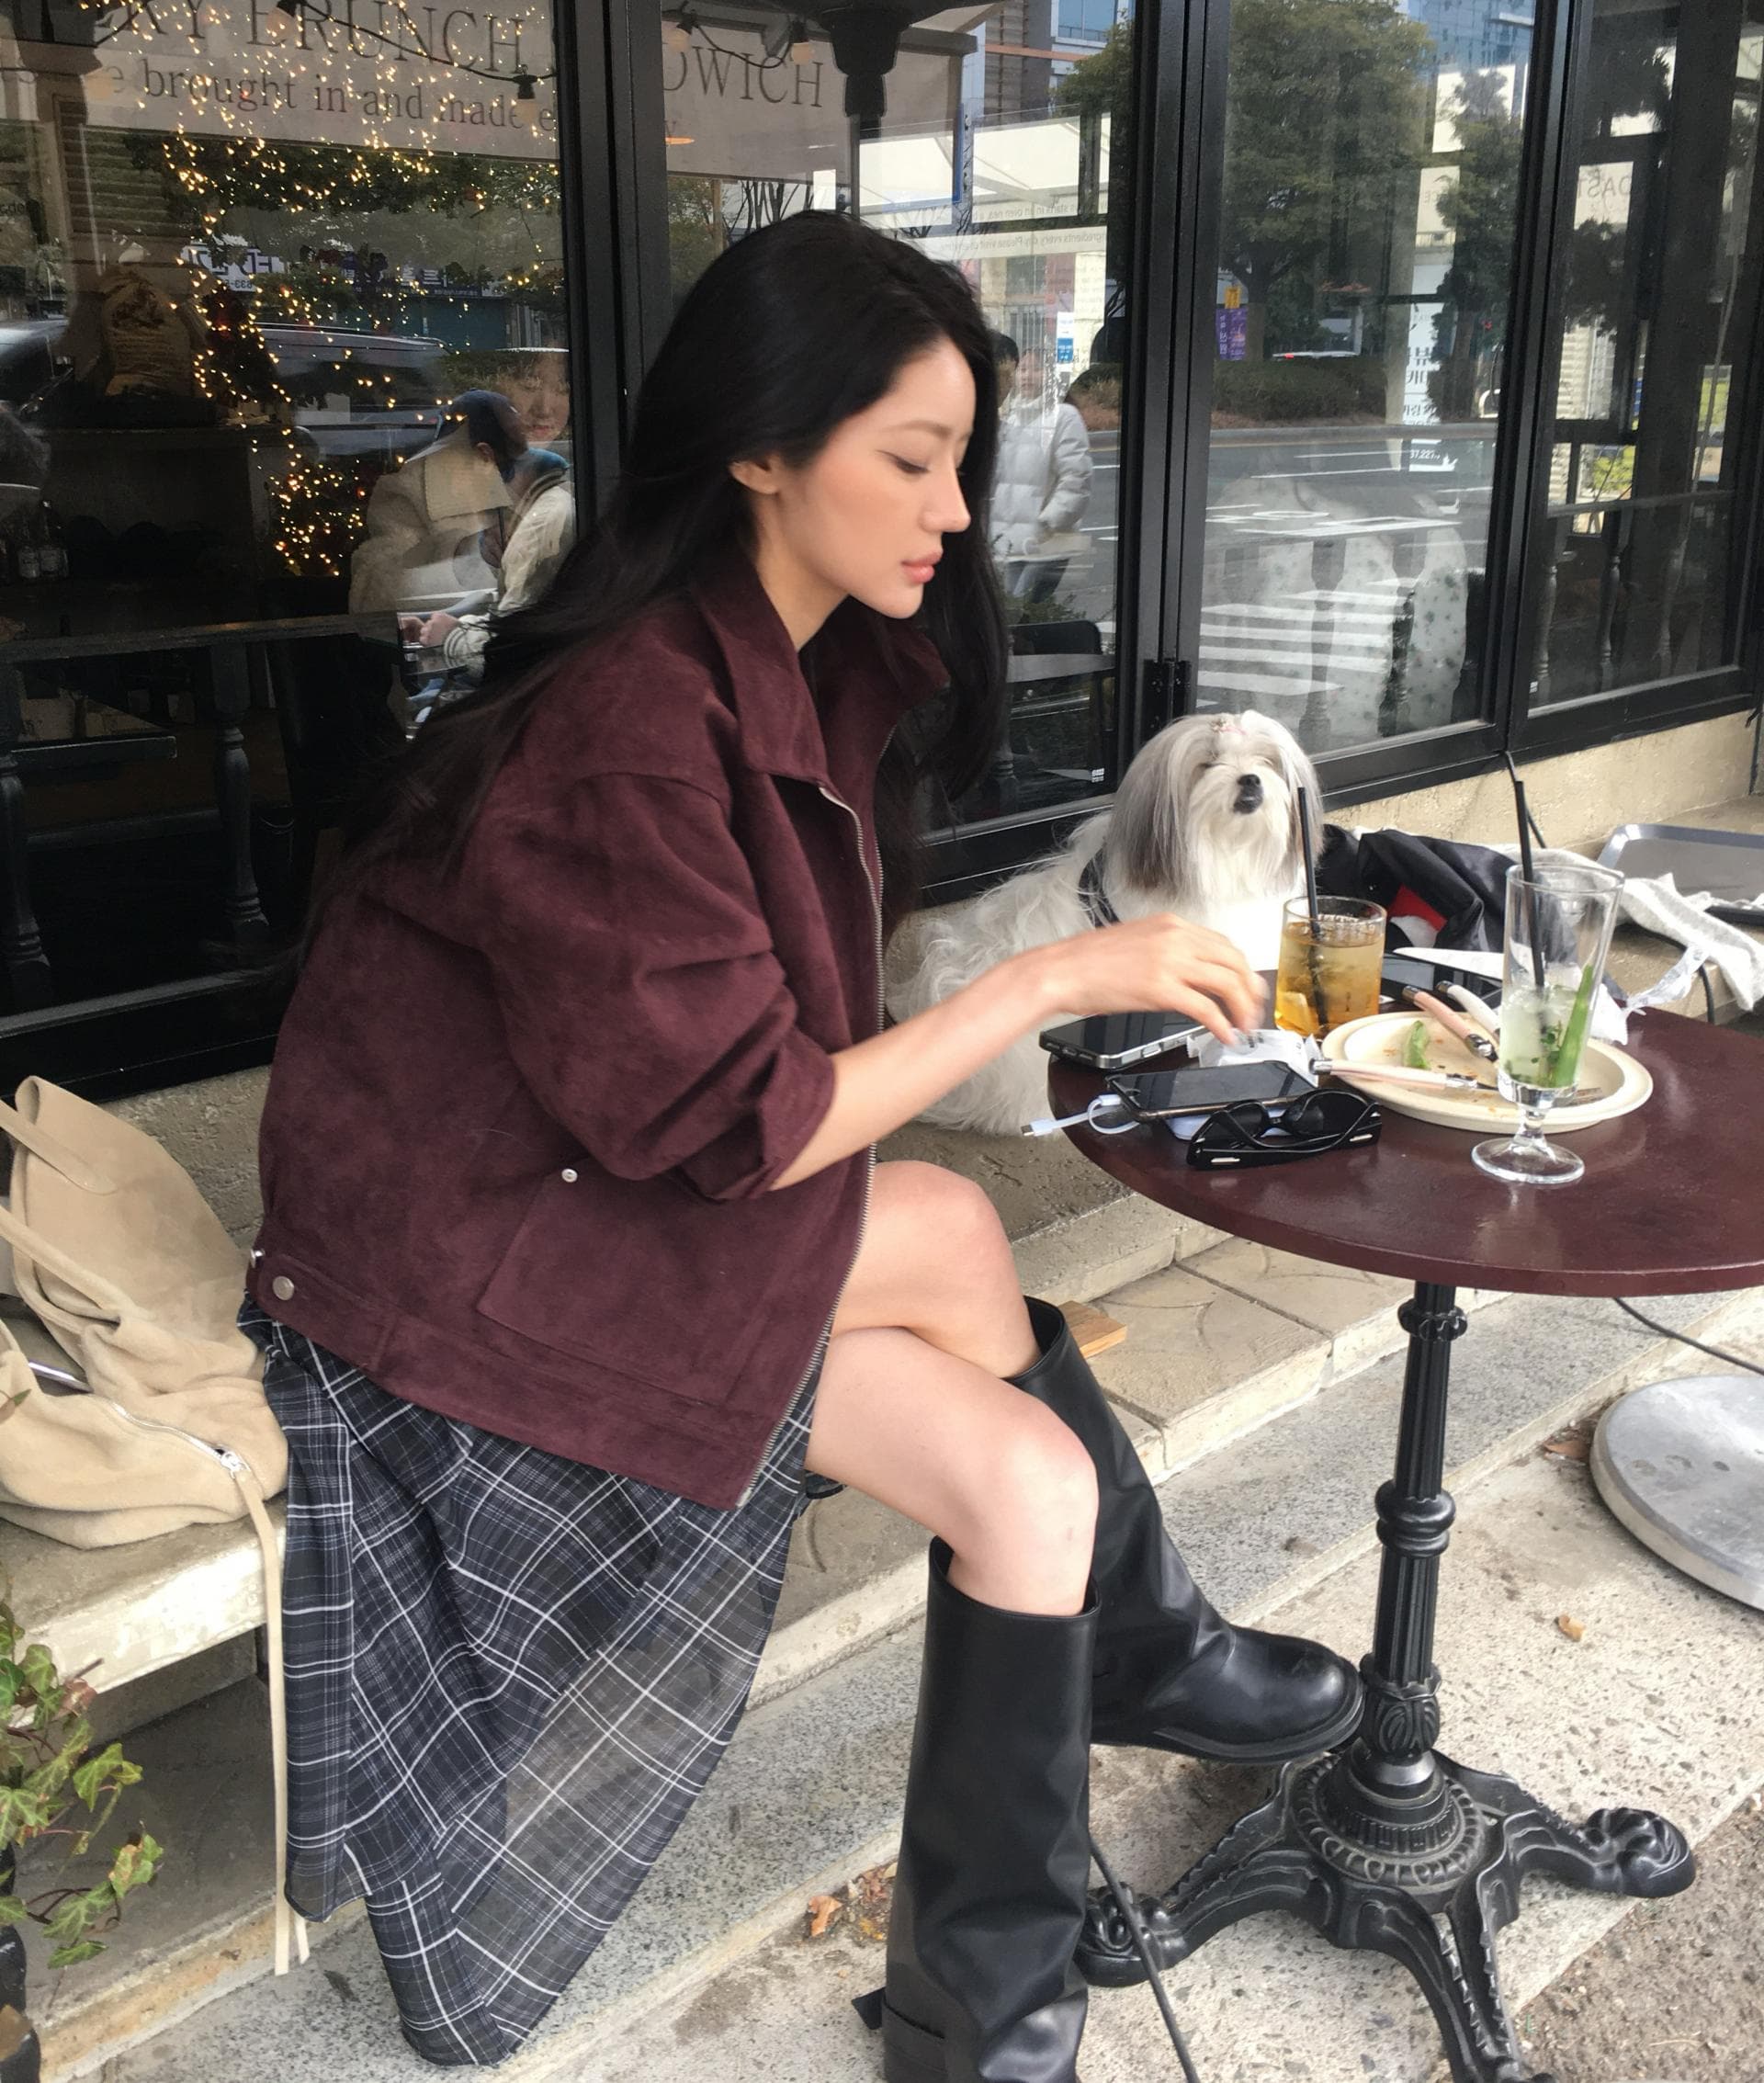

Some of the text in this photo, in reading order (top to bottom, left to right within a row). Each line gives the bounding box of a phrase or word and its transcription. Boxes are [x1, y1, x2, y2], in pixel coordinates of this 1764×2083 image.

[141, 58, 297, 111] brought
[314, 74, 347, 113] in
[364, 85, 424, 119] and
